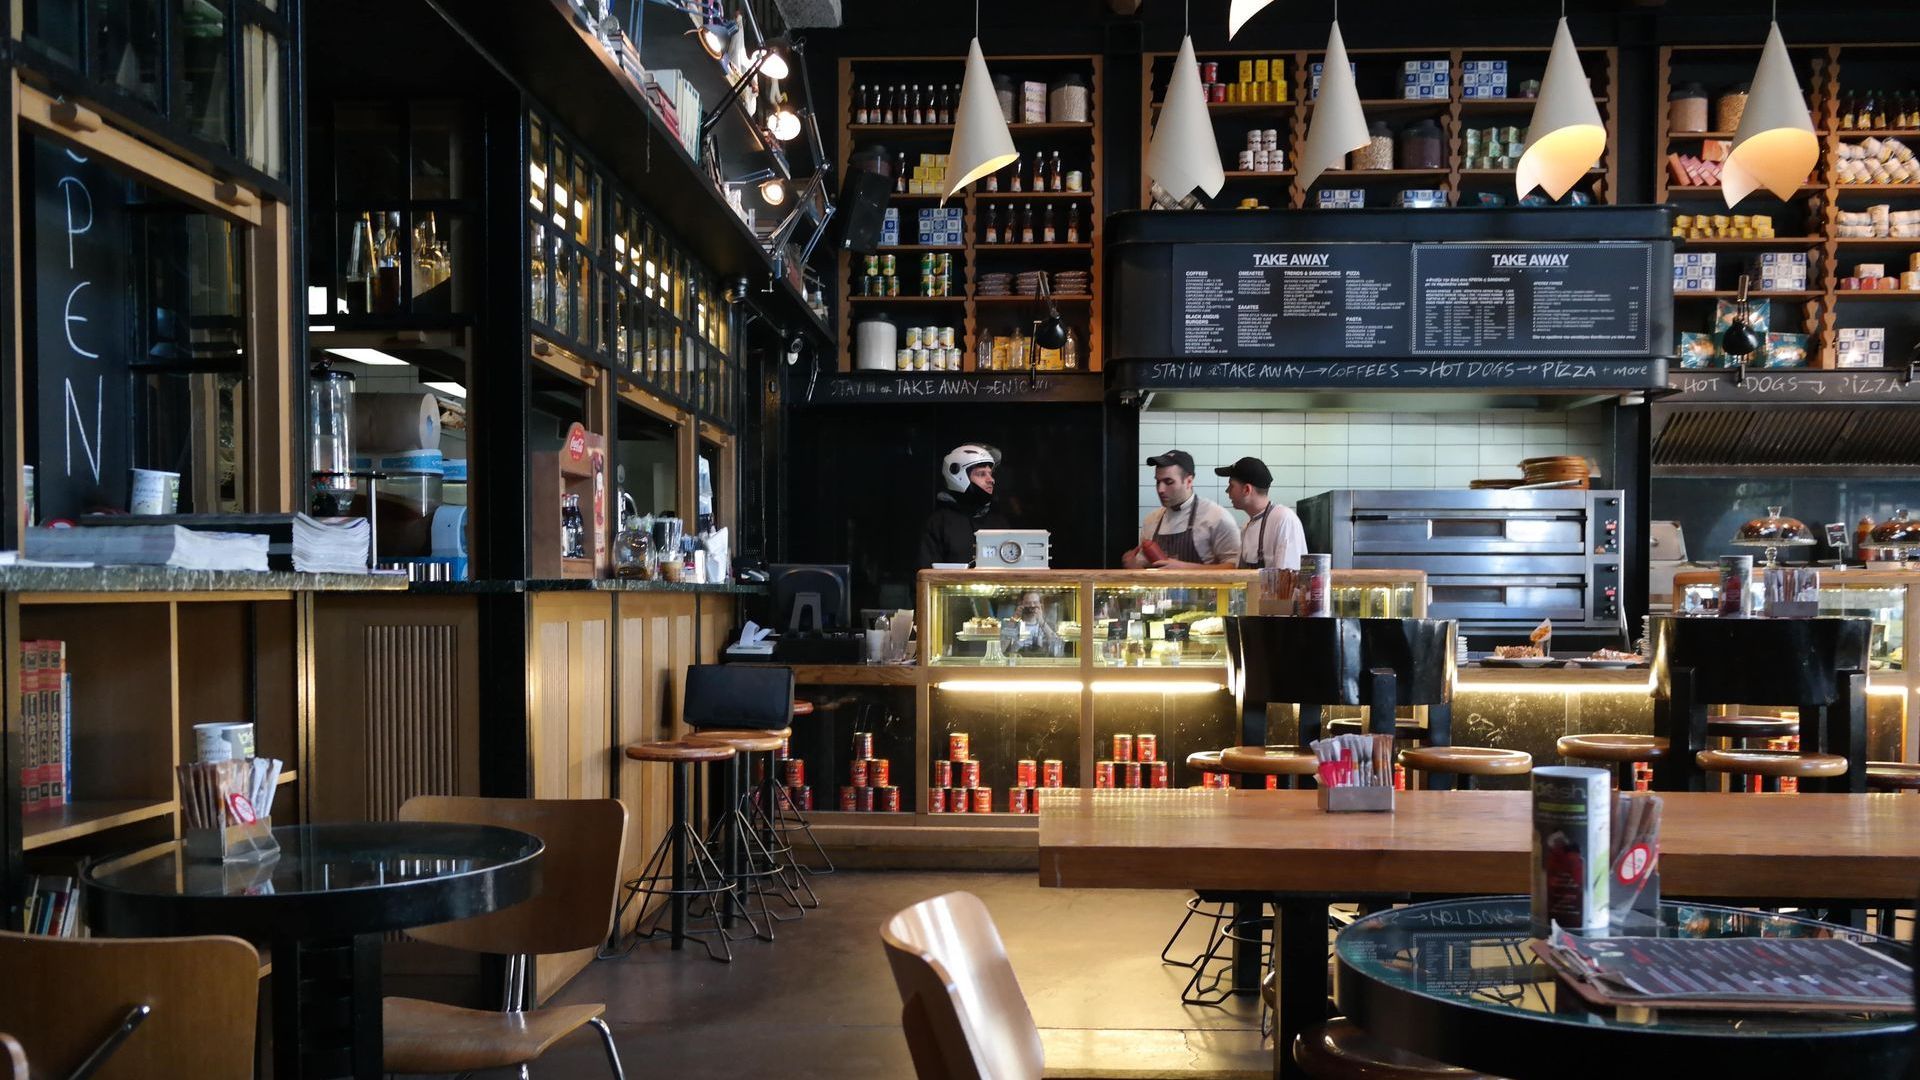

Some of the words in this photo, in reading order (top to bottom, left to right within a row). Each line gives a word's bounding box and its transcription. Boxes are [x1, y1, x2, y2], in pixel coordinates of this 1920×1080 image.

[1253, 254, 1288, 266] TAKE
[1289, 254, 1329, 266] AWAY
[1492, 254, 1527, 266] TAKE
[1529, 254, 1569, 266] AWAY
[58, 148, 102, 486] PEN
[1152, 362, 1186, 380] STAY
[1220, 362, 1255, 379] TAKE
[1259, 362, 1305, 379] AWAY
[1327, 362, 1400, 380] COFFEES
[1428, 360, 1462, 379] HOT
[1467, 361, 1515, 378] DOGS
[1613, 365, 1648, 376] more
[895, 378, 935, 396] TAKE
[938, 378, 981, 396] AWAY
[1684, 377, 1720, 393] HOT
[1744, 375, 1799, 393] DOGS
